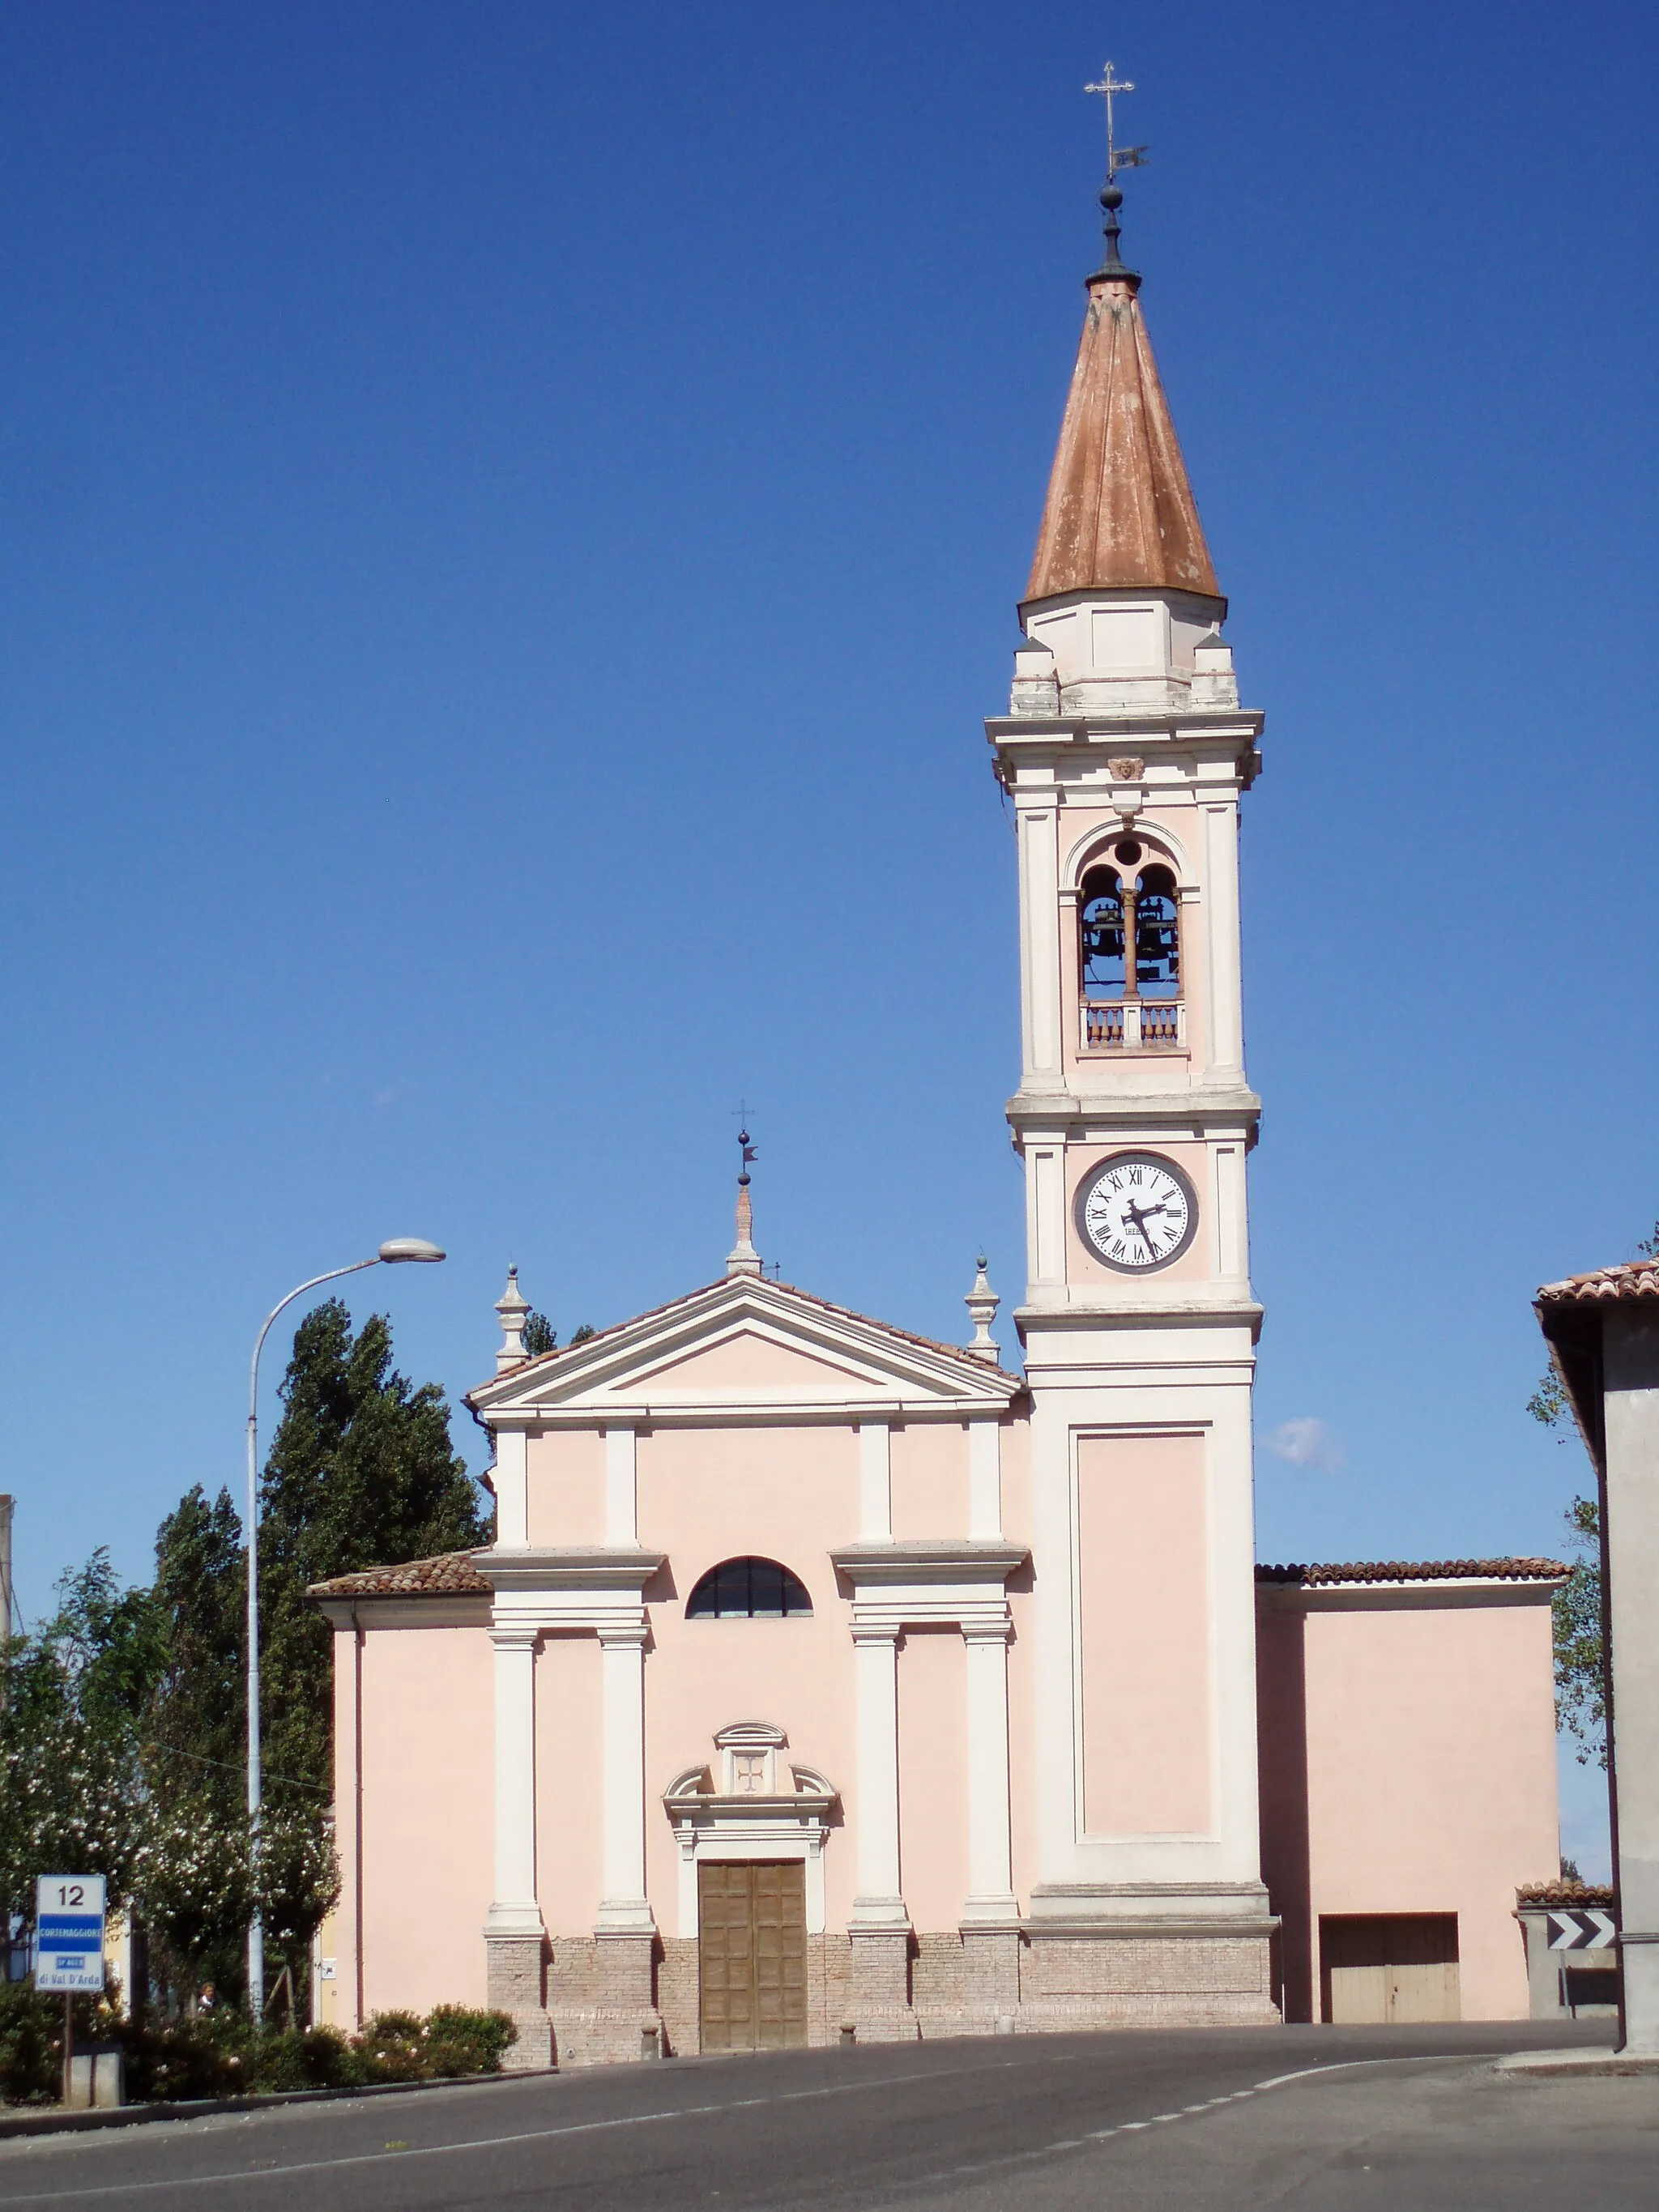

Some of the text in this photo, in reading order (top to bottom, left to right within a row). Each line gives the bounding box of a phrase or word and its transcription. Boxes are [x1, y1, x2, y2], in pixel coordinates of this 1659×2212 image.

[1108, 1175, 1124, 1192] XI
[1129, 1170, 1142, 1185] XII
[1095, 1190, 1112, 1204] X
[1162, 1190, 1175, 1200] II
[1091, 1208, 1107, 1219] IX
[1166, 1209, 1182, 1217] III
[1094, 1225, 1113, 1245] VIII
[1162, 1225, 1178, 1242] IV
[1111, 1238, 1126, 1258] VII
[1134, 1244, 1145, 1259] VI
[58, 1886, 84, 1906] 12
[40, 1928, 101, 1937] CORTEMAGGIORE
[40, 1974, 100, 1984] di Val D'Arda
